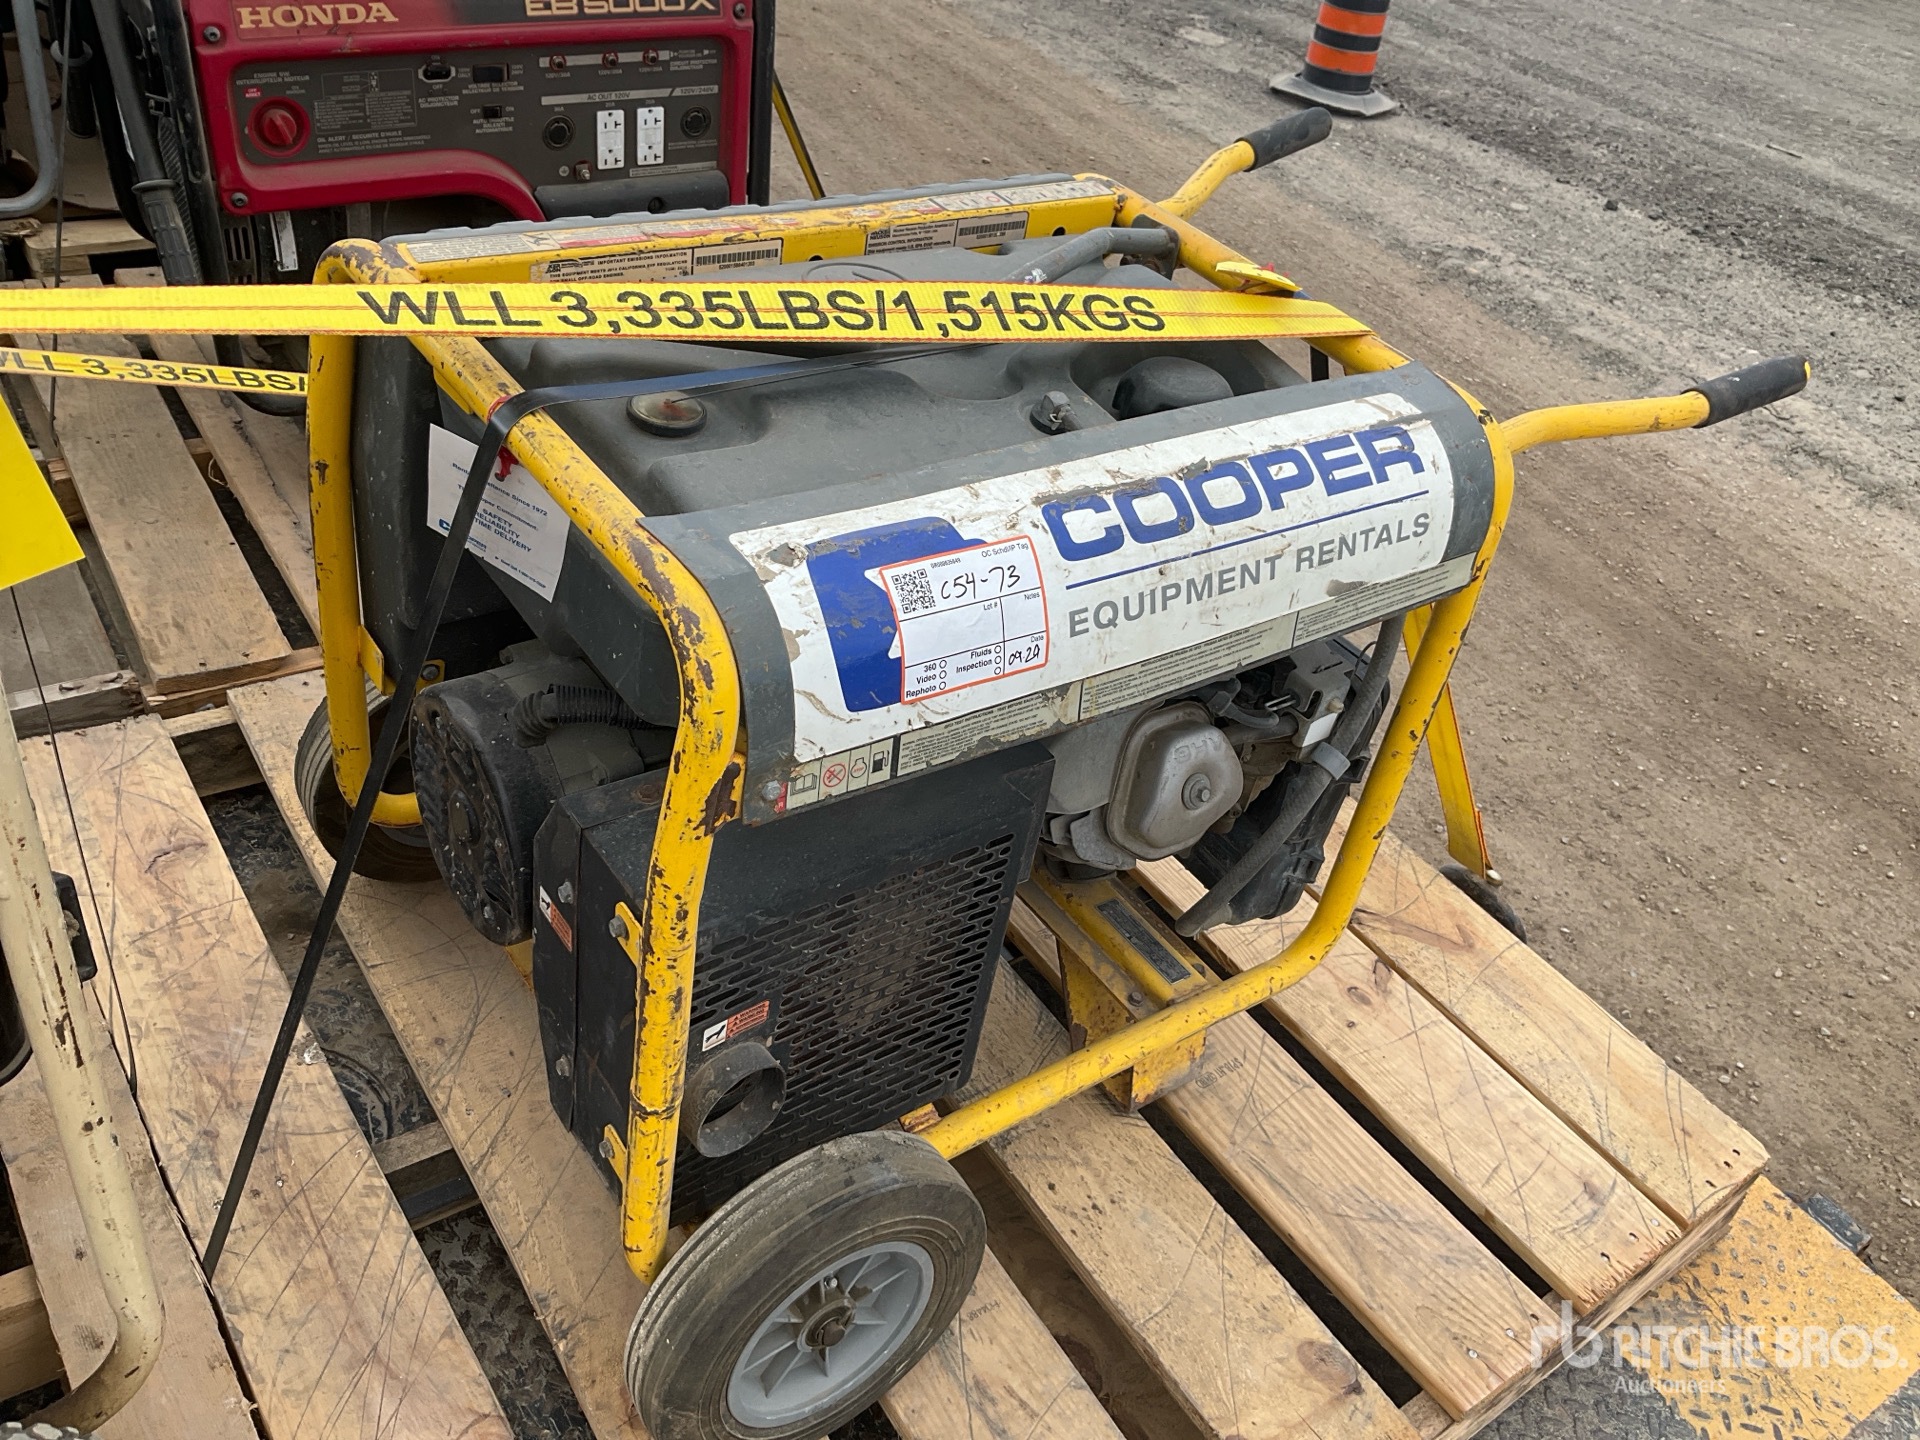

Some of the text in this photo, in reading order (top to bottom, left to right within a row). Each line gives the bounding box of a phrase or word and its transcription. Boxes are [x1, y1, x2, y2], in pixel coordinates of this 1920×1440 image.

[236, 2, 399, 29] HONDA
[680, 86, 715, 94] 120V/240V
[357, 289, 1166, 337] WLL 3,335LBS/1,515KGS
[0, 351, 74, 373] LL
[1041, 426, 1424, 562] COOPER
[511, 494, 530, 507] Since
[532, 505, 548, 517] 1972
[482, 508, 513, 528] SAFETY
[494, 528, 532, 552] DELIVERY
[981, 549, 992, 558] OC
[1016, 542, 1029, 551] Tag
[1068, 555, 1286, 638] EQUIPMENT
[1296, 512, 1431, 573] RENTALS
[1024, 592, 1041, 601] Notes
[983, 603, 993, 611] Lot
[1030, 634, 1044, 643] Date
[970, 647, 992, 659] Fluids
[923, 663, 937, 673] 360
[956, 658, 993, 674] Inspection
[916, 673, 937, 684] Video
[905, 685, 937, 699] Rephoto
